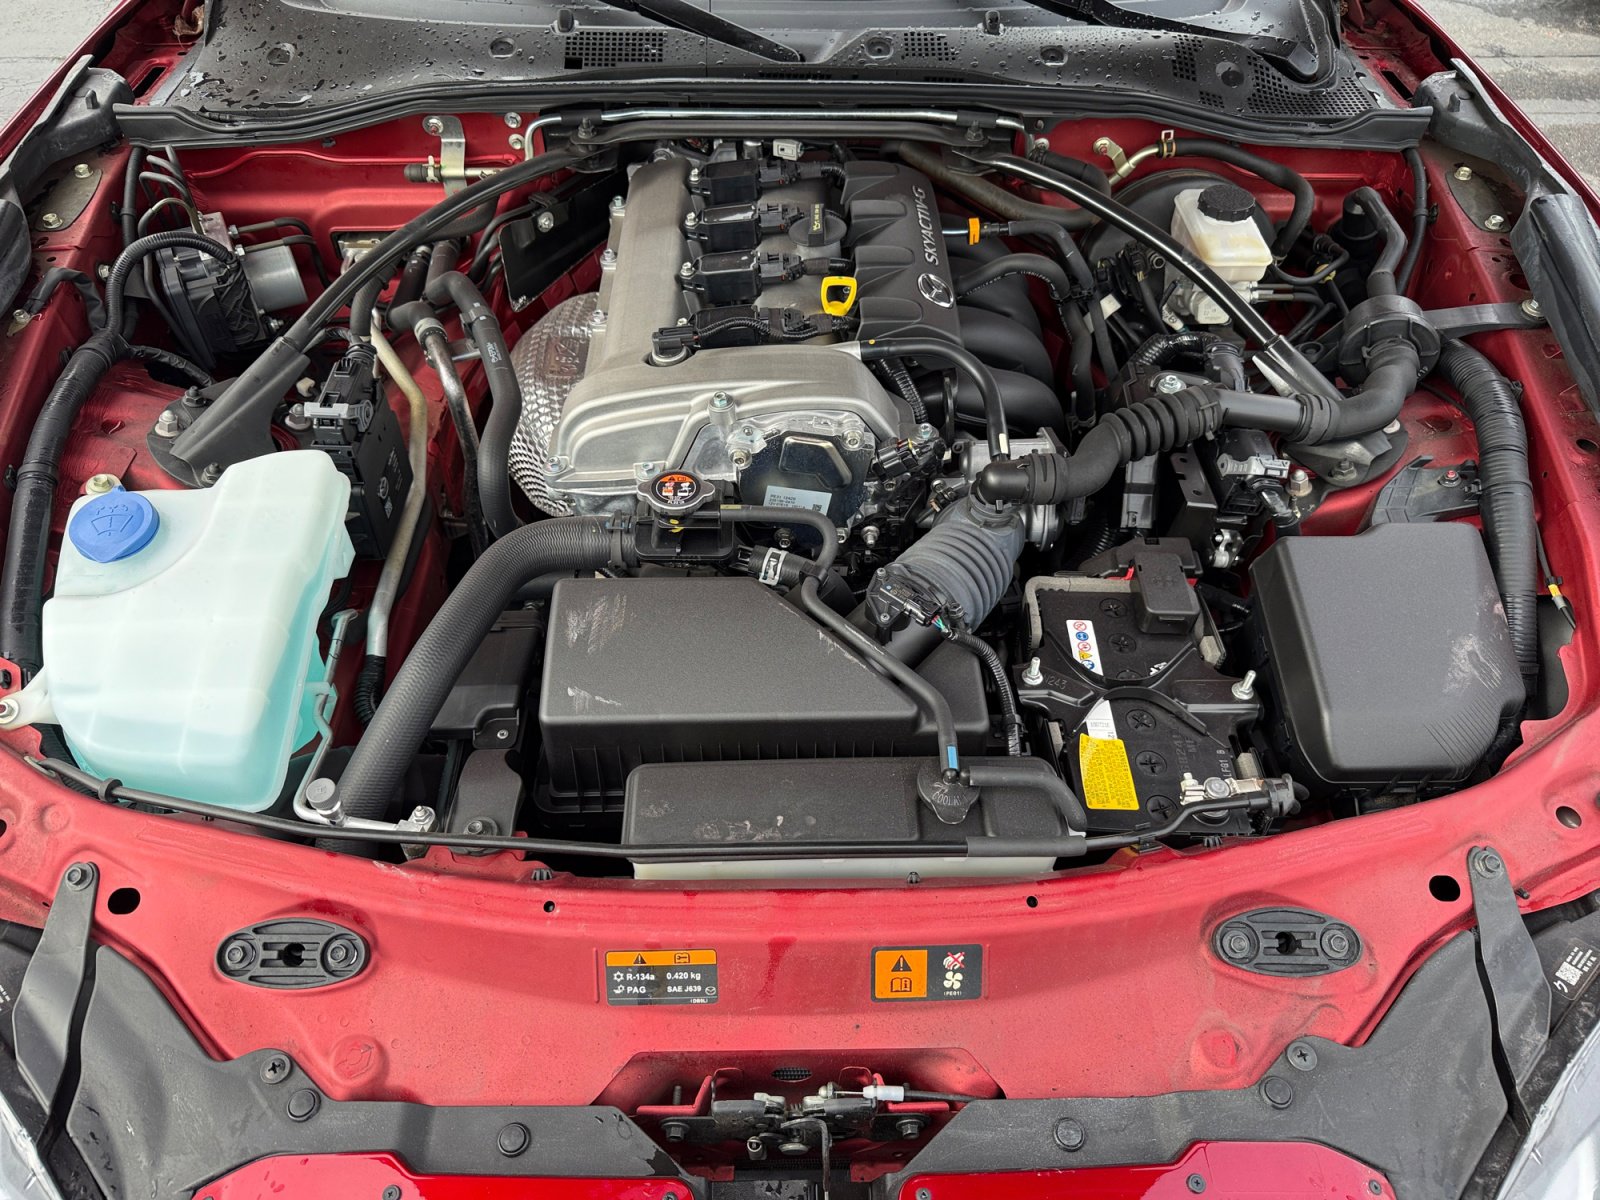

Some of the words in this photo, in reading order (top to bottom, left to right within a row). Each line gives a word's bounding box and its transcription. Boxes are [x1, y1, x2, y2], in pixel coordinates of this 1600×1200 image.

[912, 185, 939, 266] SKYACTIV-G
[626, 973, 656, 981] R-134a
[666, 972, 689, 980] 0.420
[690, 972, 701, 980] kg
[626, 986, 647, 994] PAG
